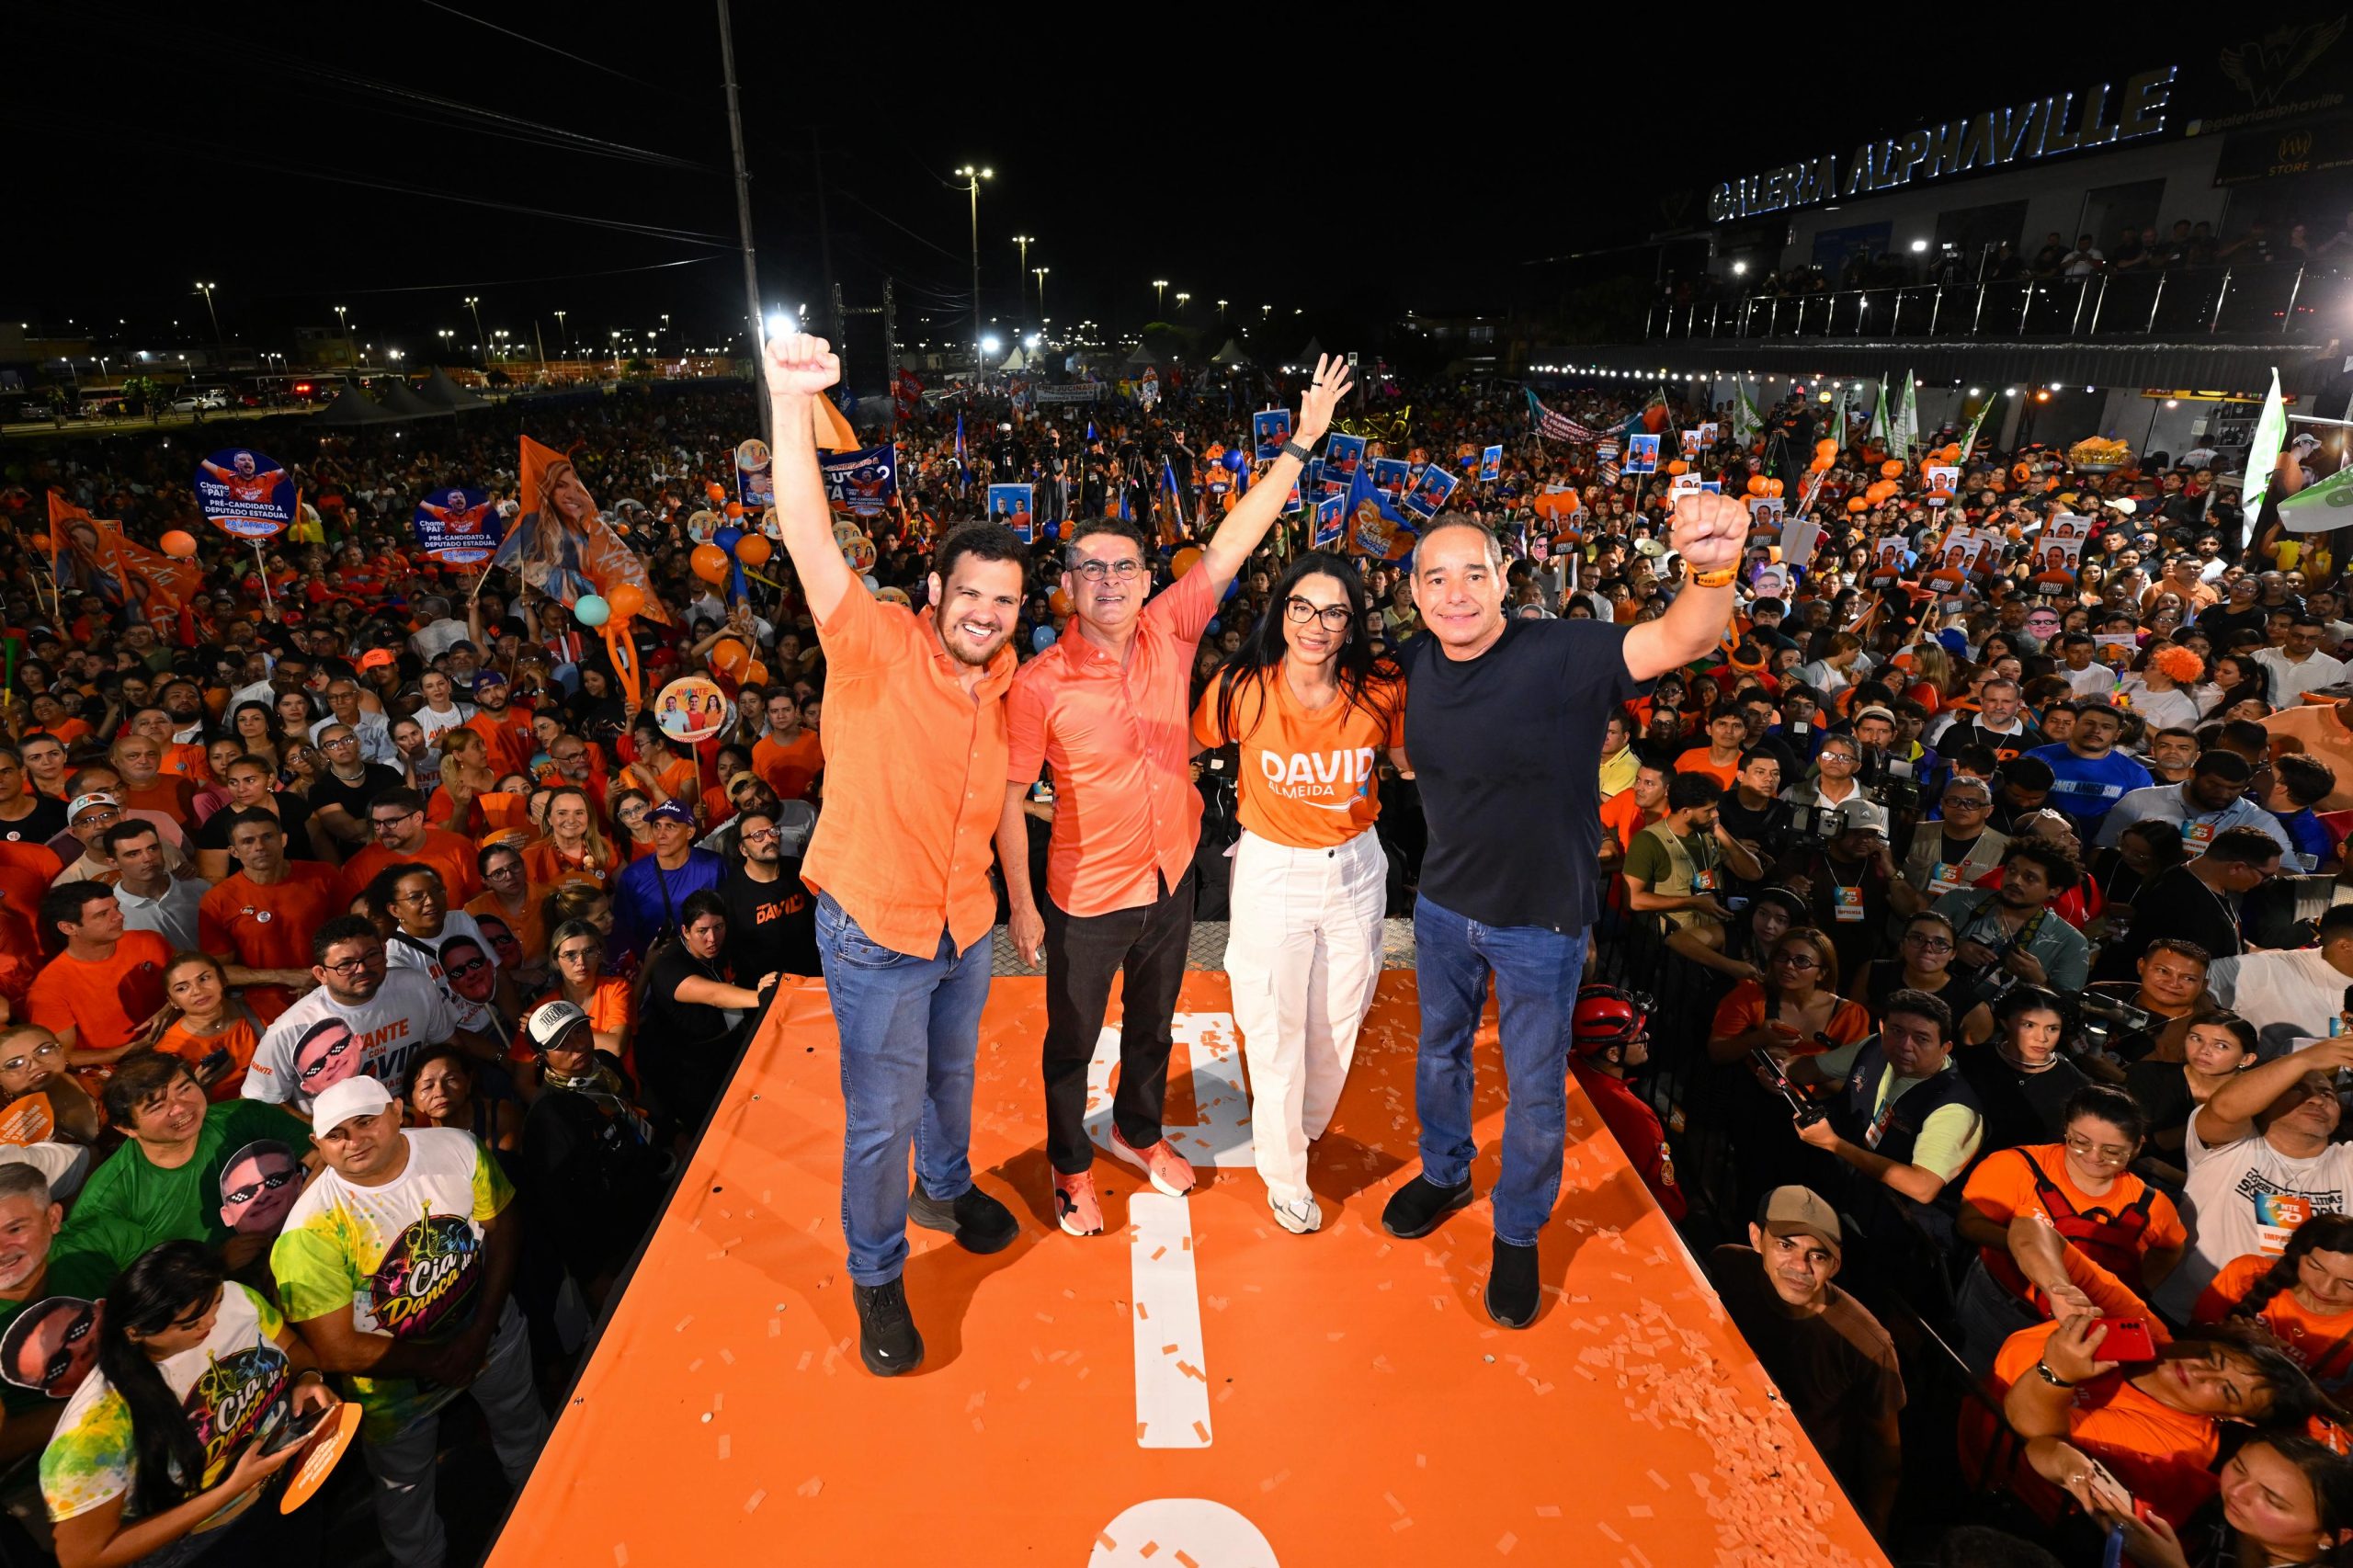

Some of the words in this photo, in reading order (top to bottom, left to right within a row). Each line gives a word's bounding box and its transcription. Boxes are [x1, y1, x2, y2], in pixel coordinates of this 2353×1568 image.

[1707, 154, 1836, 223] GALERIA
[1844, 65, 2178, 196] ALPHAVILLE
[2268, 161, 2310, 176] STORE
[199, 482, 230, 490] Chama
[208, 489, 223, 497] PAI
[205, 506, 248, 516] DEPUTADO
[249, 510, 290, 519] ESTADUAL
[210, 499, 275, 511] PRÉ-CANDIDATO
[1261, 746, 1376, 787] DAVID
[1267, 780, 1336, 800] ALMEIDA
[756, 892, 806, 925] DAVID
[369, 1046, 387, 1059] COM
[2277, 1210, 2302, 1223] 70
[409, 1252, 458, 1297] Cia
[460, 1253, 472, 1271] de
[382, 1267, 460, 1327] Dança
[217, 1376, 262, 1433] Cia
[267, 1369, 280, 1389] de
[205, 1389, 267, 1464] Dança
